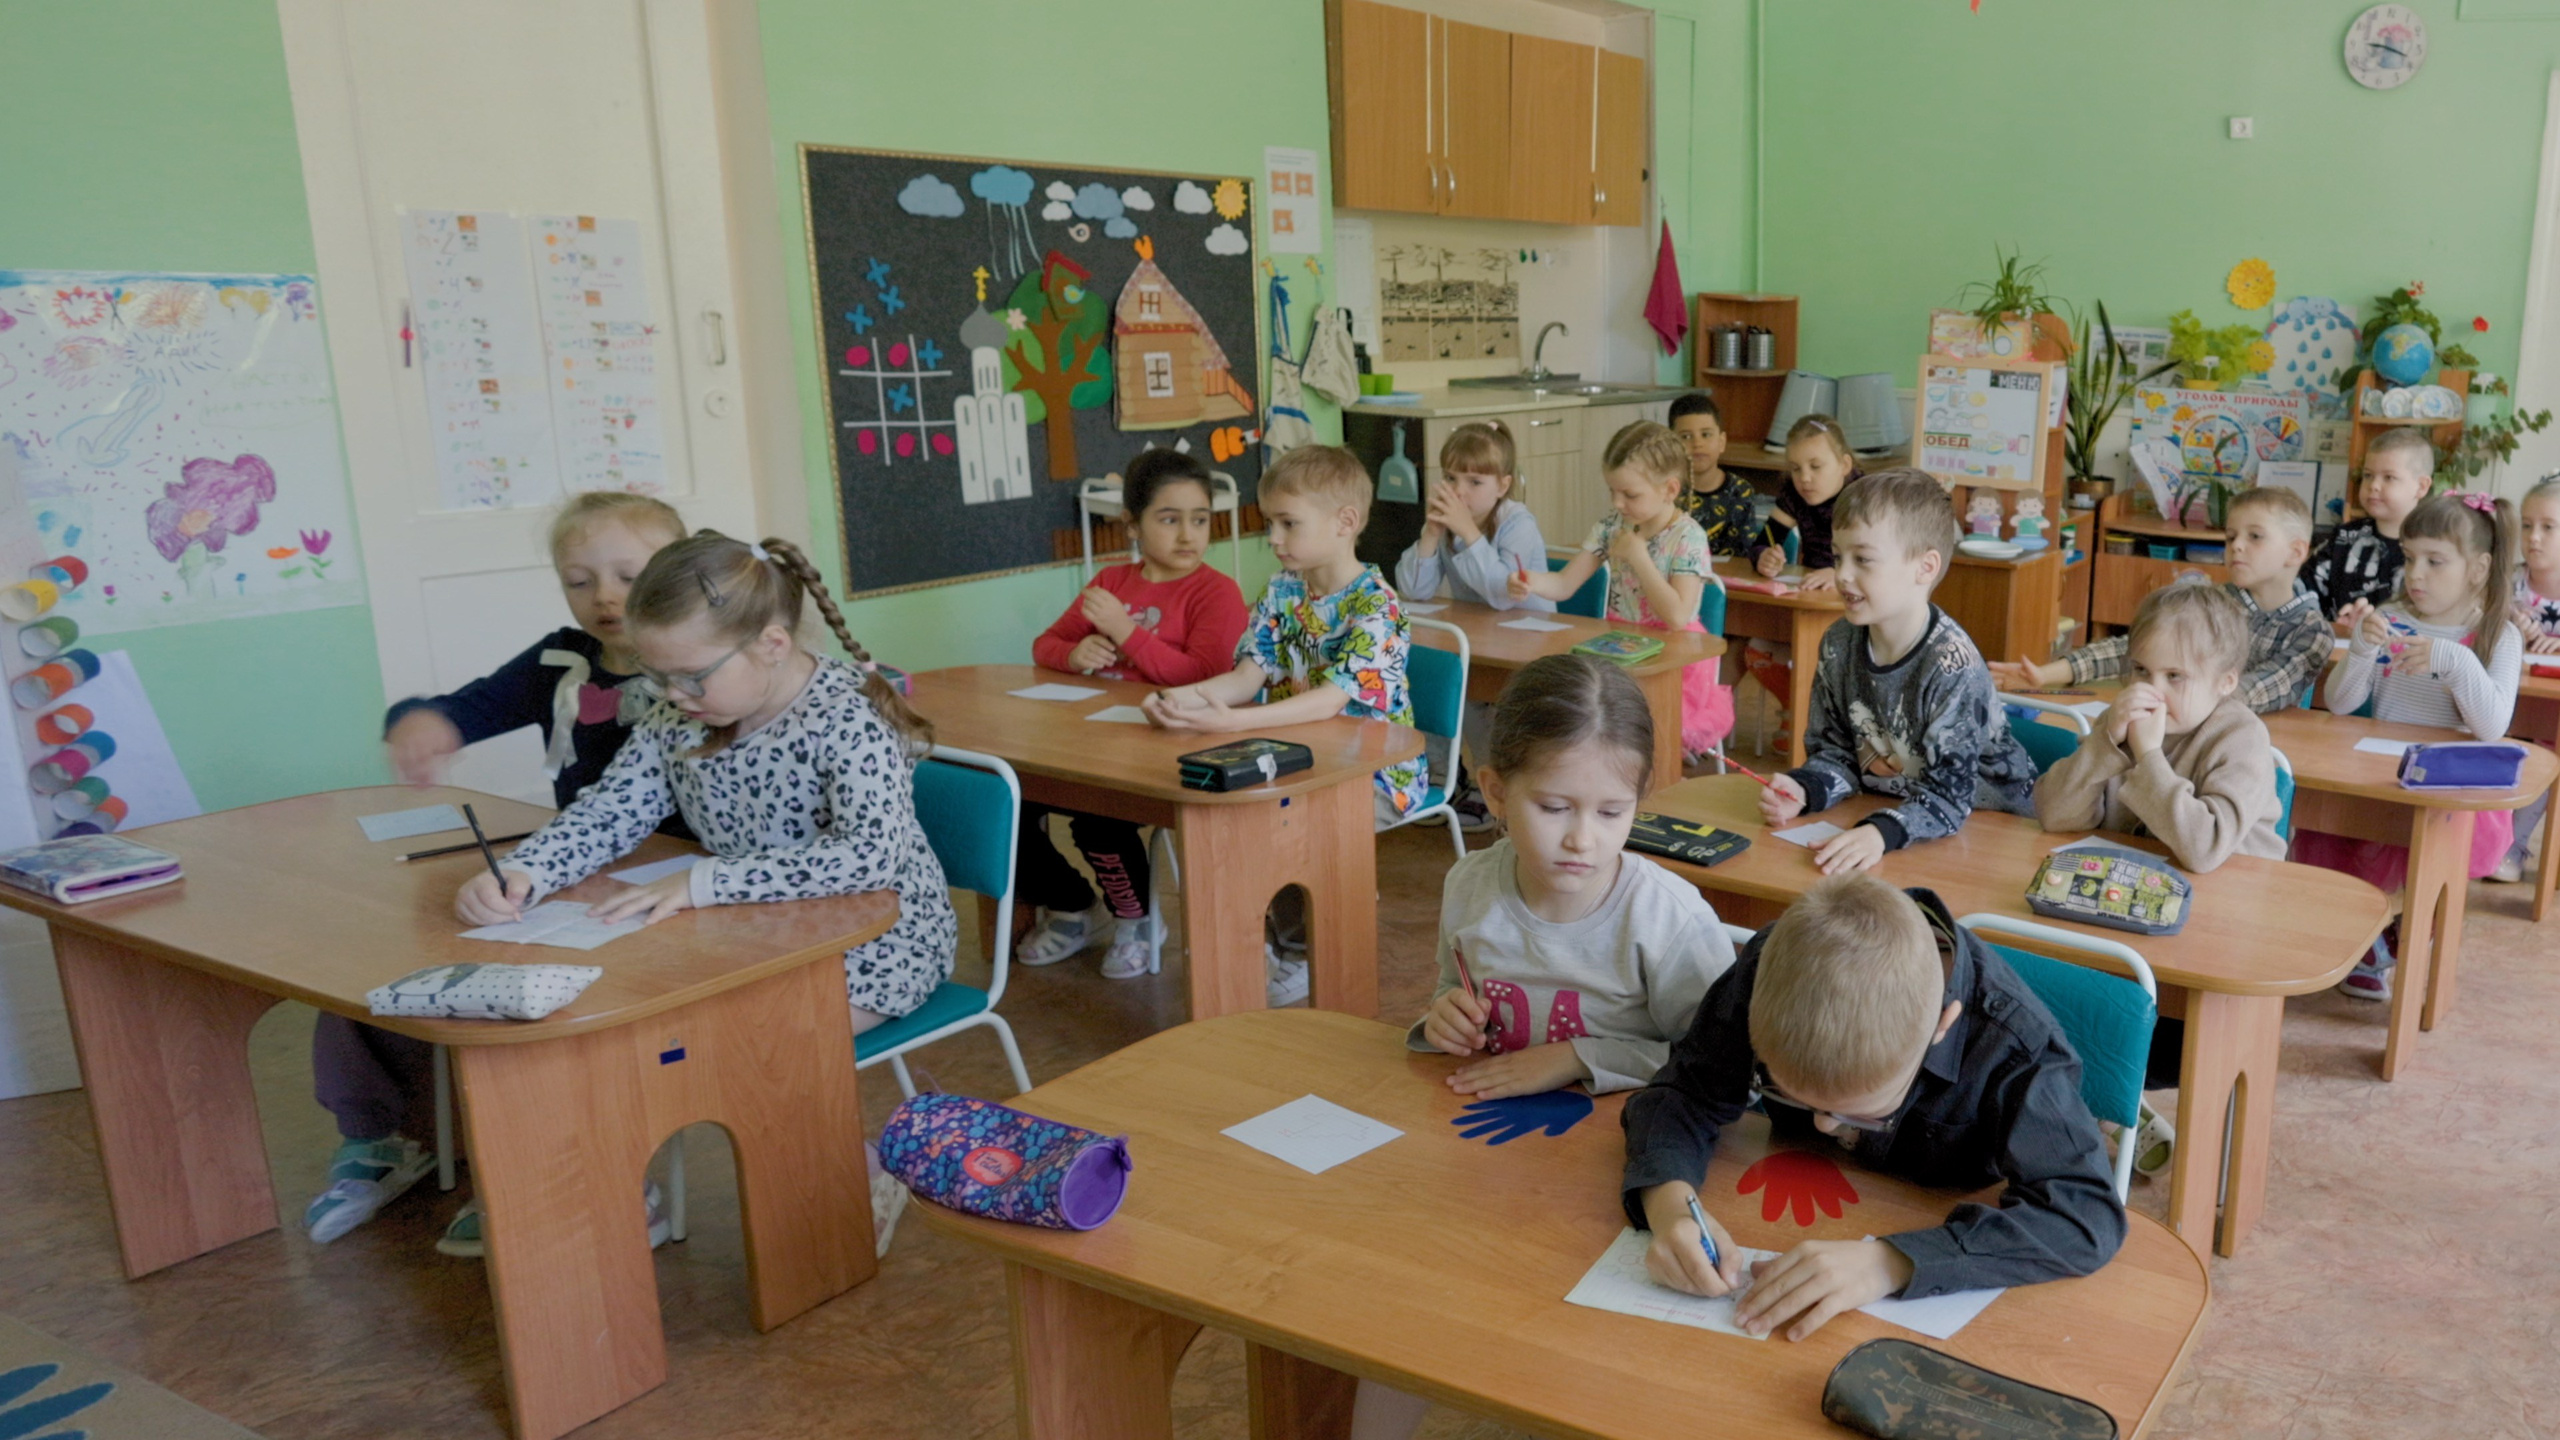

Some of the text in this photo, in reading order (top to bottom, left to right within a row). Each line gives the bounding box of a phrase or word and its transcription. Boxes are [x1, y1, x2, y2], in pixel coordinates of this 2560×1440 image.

[1999, 374, 2041, 391] МЕНЮ
[2175, 390, 2299, 408] УГОЛОК ПРИРОДЫ
[1926, 435, 1970, 448] ОБЕД
